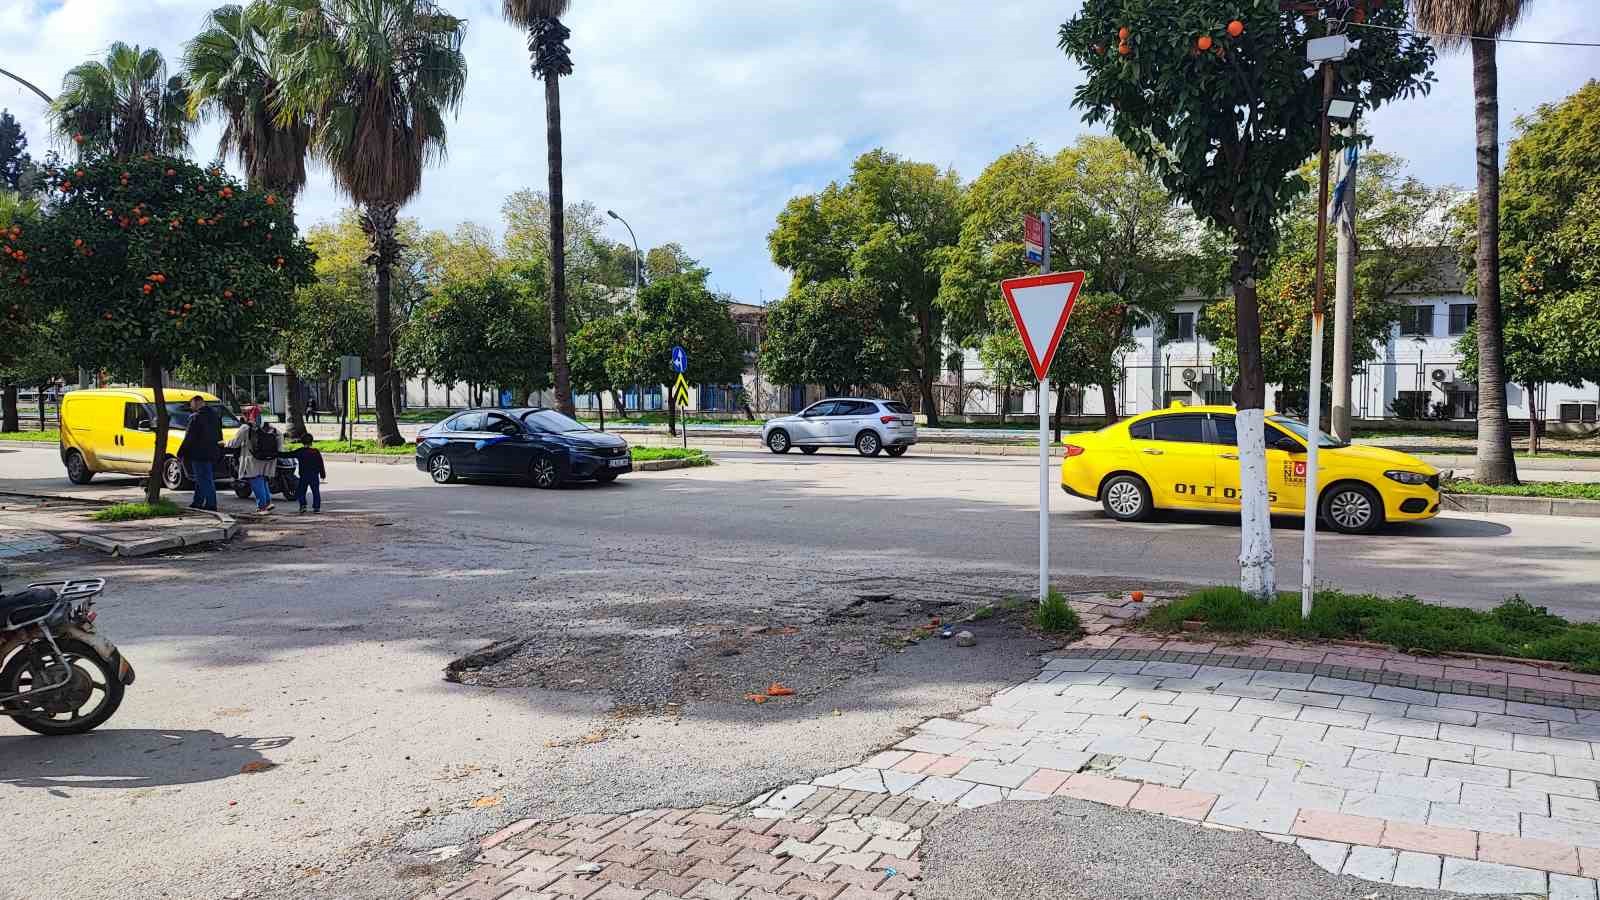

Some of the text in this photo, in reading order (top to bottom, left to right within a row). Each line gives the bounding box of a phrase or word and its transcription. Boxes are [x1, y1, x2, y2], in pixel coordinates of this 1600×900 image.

[1174, 483, 1278, 502] 01 T 05
